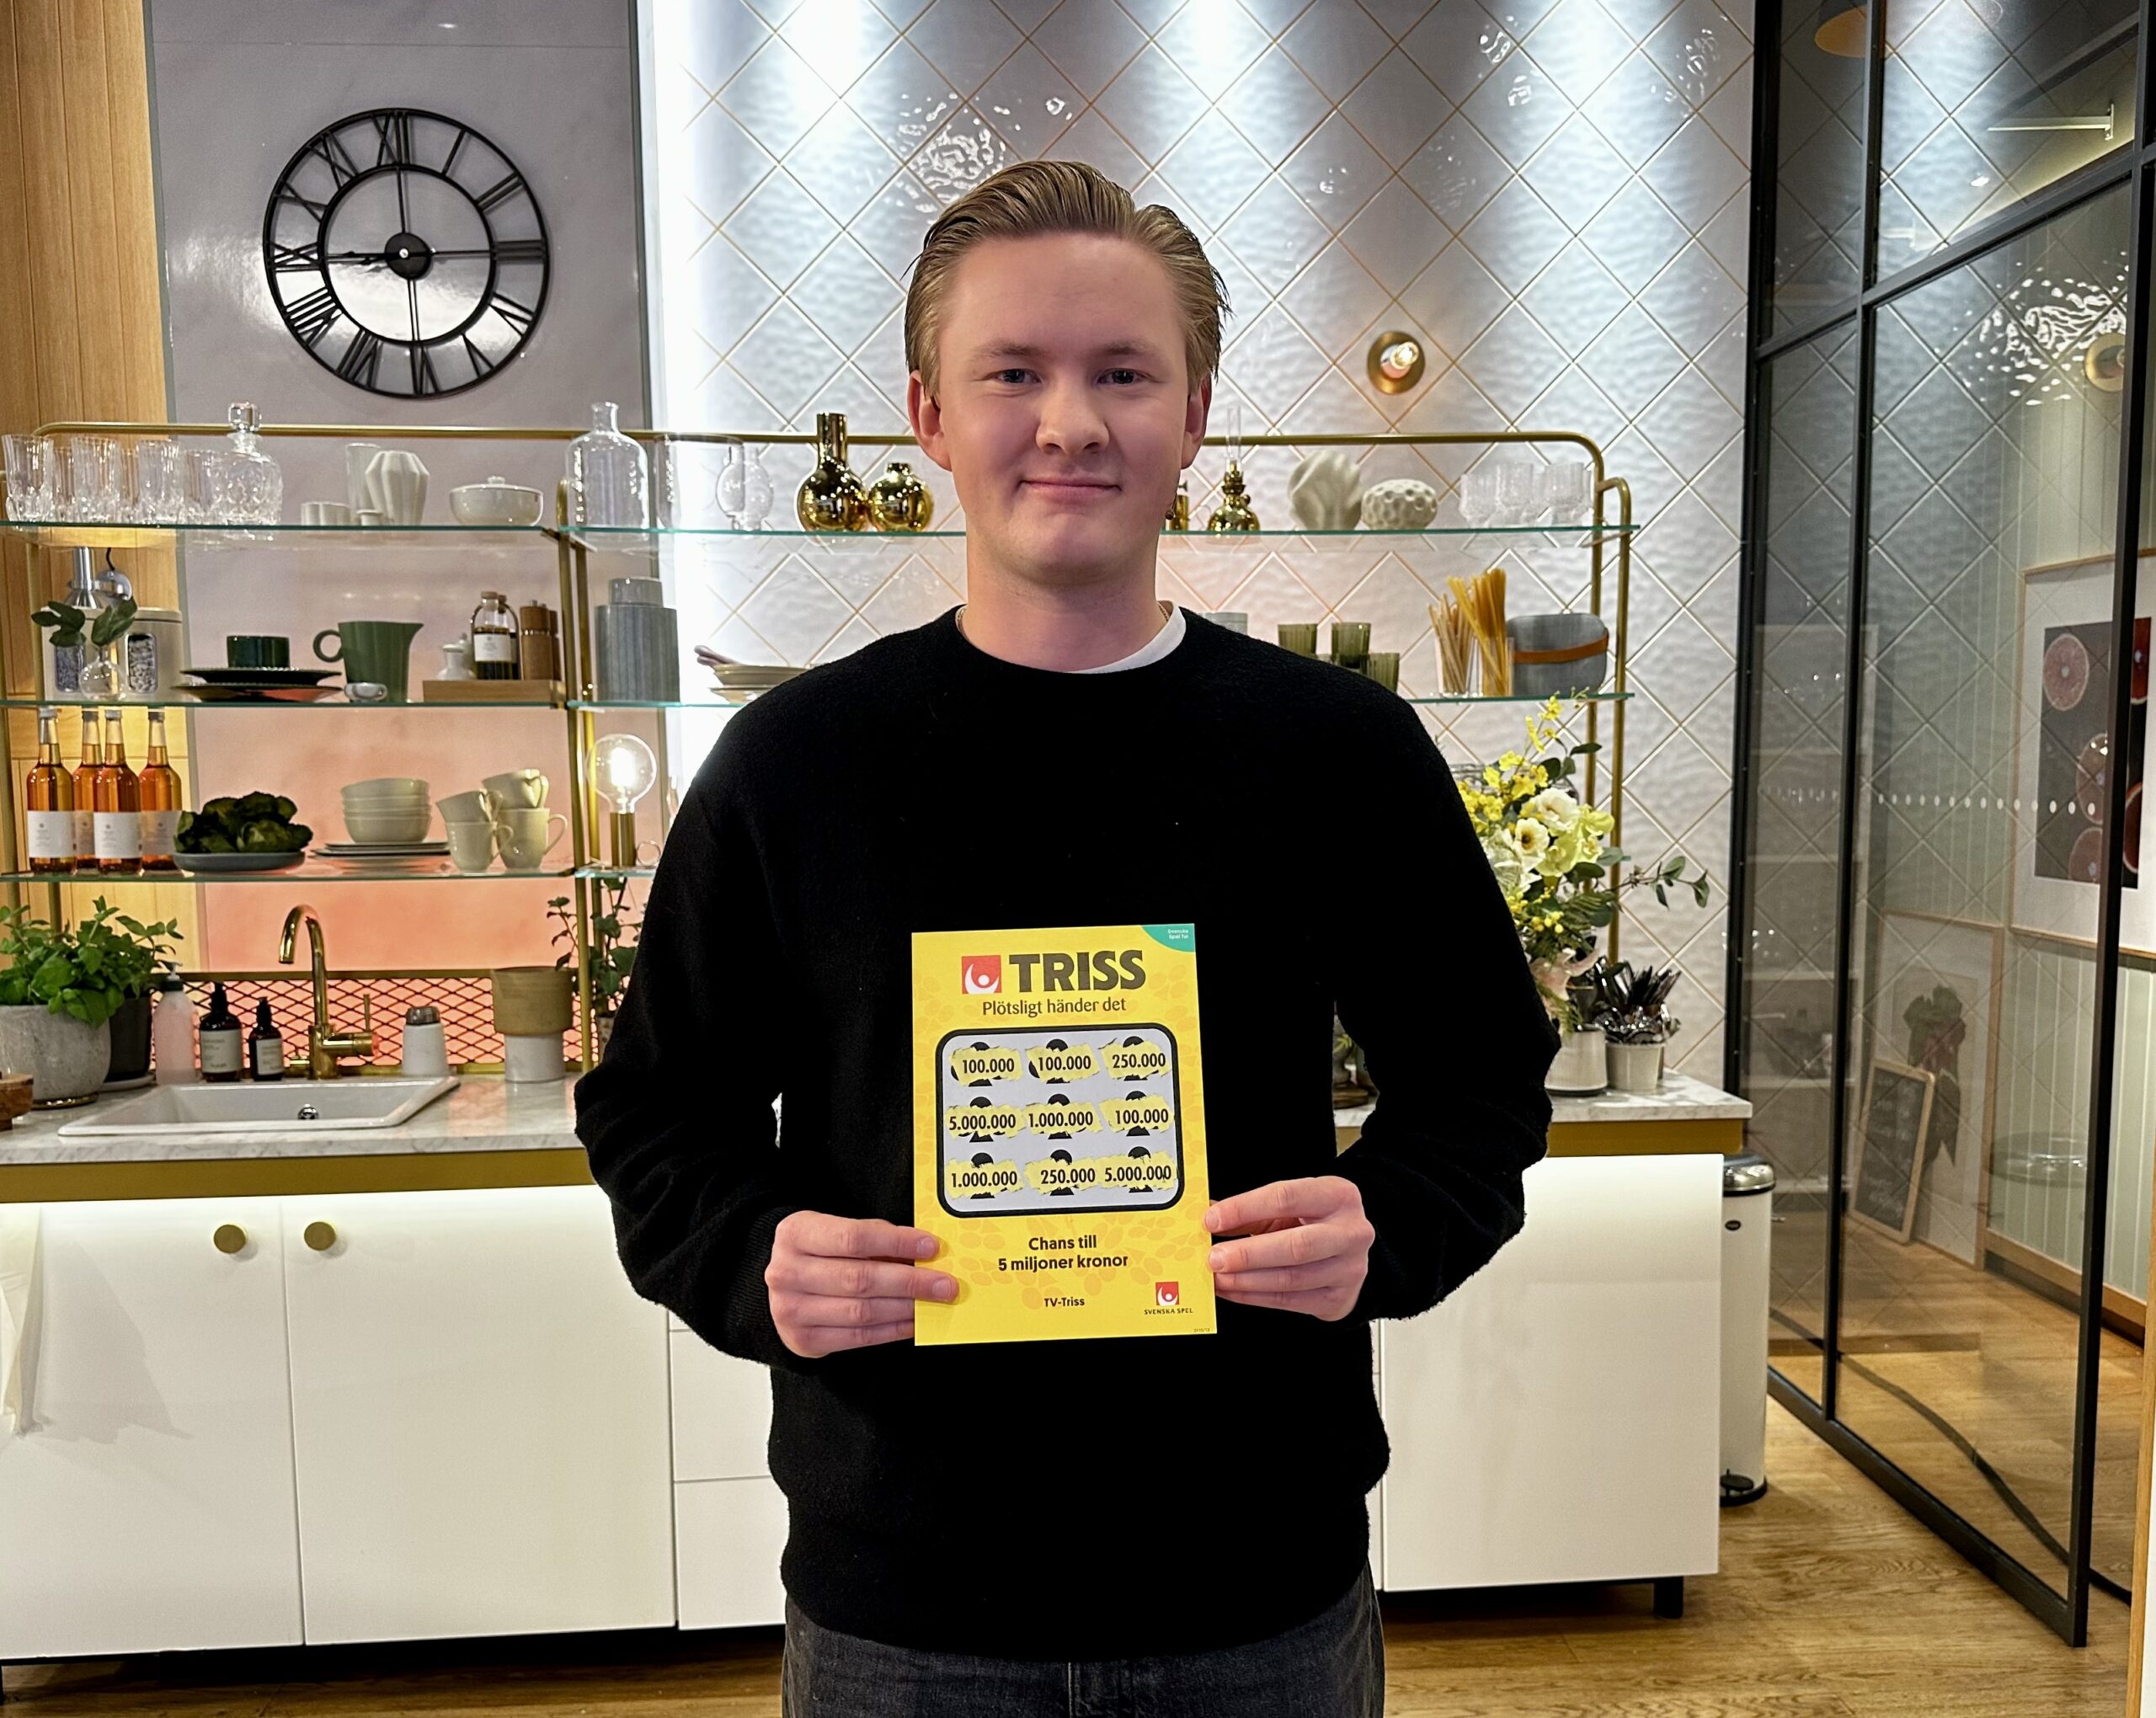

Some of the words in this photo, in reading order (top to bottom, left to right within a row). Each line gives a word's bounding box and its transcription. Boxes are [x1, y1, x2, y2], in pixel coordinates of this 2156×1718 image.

[1008, 949, 1147, 993] TRISS
[982, 1000, 1043, 1017] Plötsligt
[1046, 998, 1099, 1013] händer
[1102, 996, 1126, 1011] det
[962, 1058, 1015, 1074] 100.000
[1038, 1055, 1091, 1071] 100.000
[1112, 1053, 1166, 1070] 250.000
[948, 1113, 1017, 1131] 5.000.000
[1027, 1111, 1094, 1128] 1.000.000
[1114, 1108, 1170, 1125] 100.000
[950, 1171, 1018, 1188] 1.000.000
[1040, 1168, 1096, 1185] 250.000
[1104, 1165, 1172, 1182] 5.000.000
[1028, 1236, 1075, 1251] Chans
[1077, 1235, 1097, 1249] till
[997, 1257, 1007, 1272] 5
[1010, 1256, 1074, 1273] miljoner
[1076, 1254, 1129, 1268] kronor
[1043, 1296, 1086, 1308] TV-Triss
